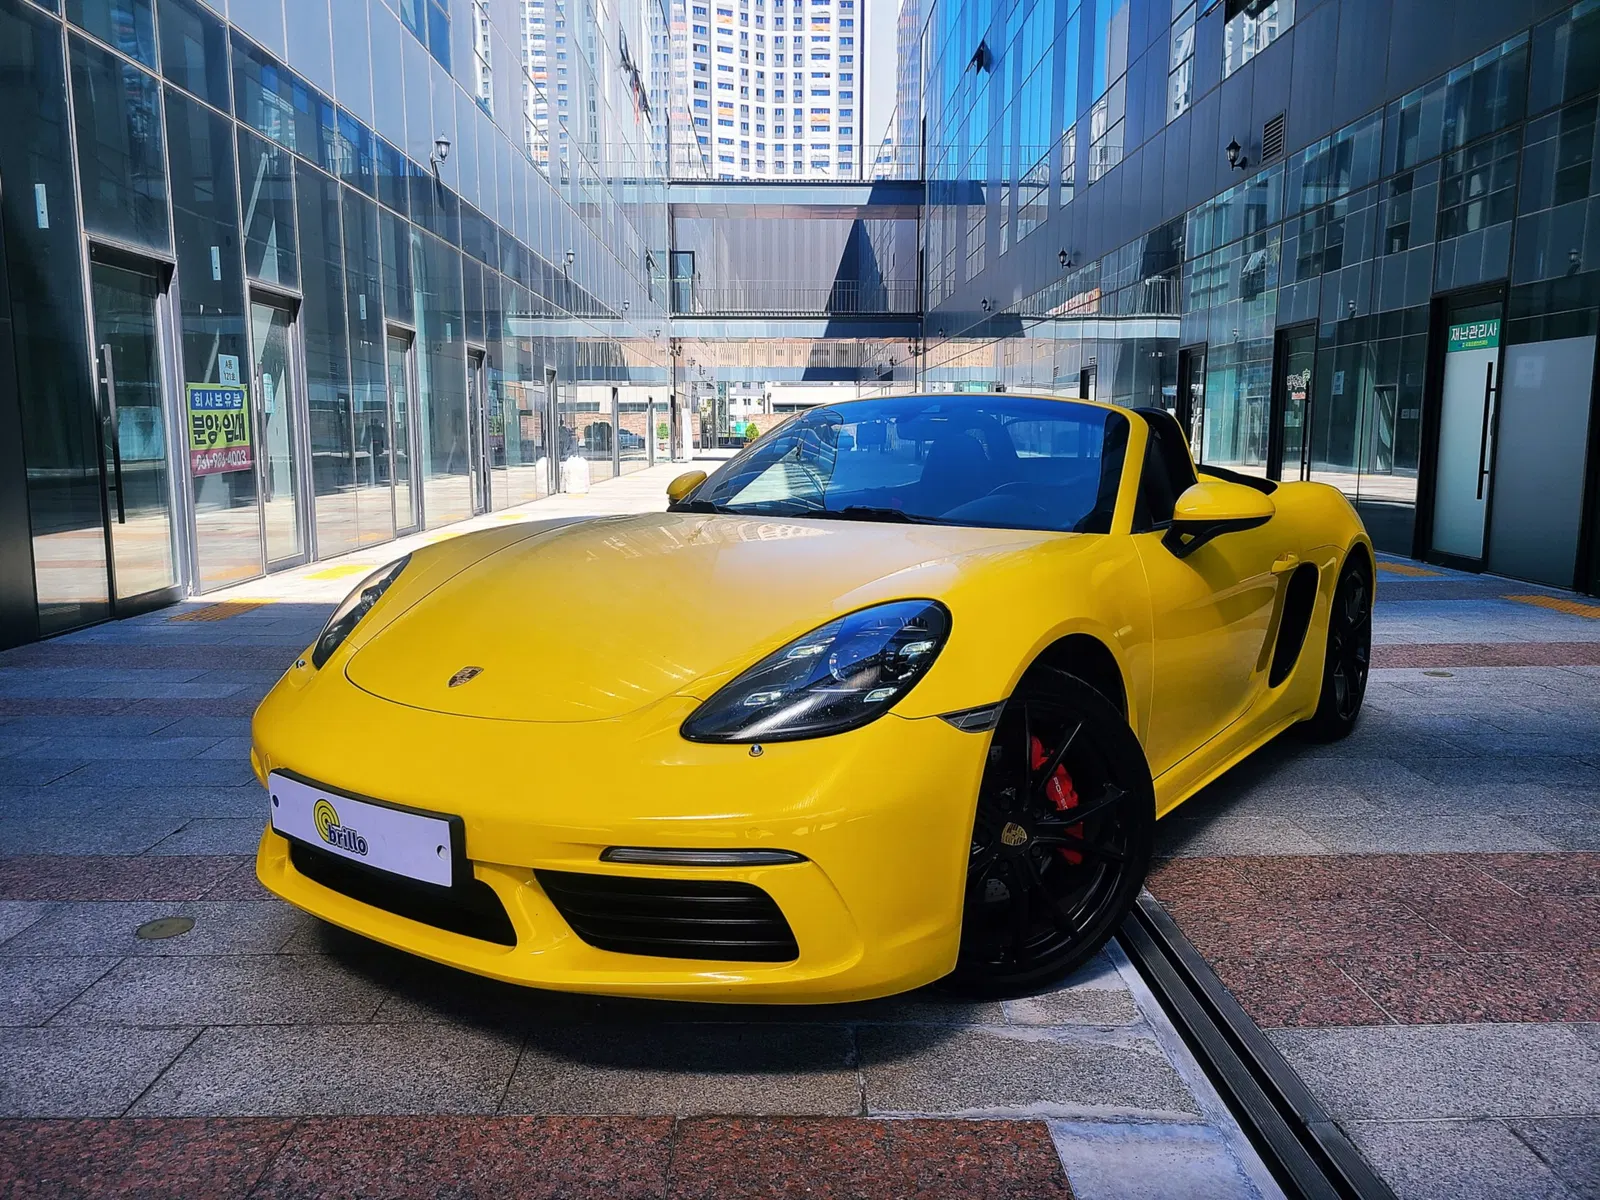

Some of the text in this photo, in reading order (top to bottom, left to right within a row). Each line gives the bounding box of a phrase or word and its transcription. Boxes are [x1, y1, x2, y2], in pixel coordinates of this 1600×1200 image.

[1451, 322, 1497, 340] 재난관리사
[194, 392, 242, 407] 회사보유분
[328, 824, 368, 855] brillo
